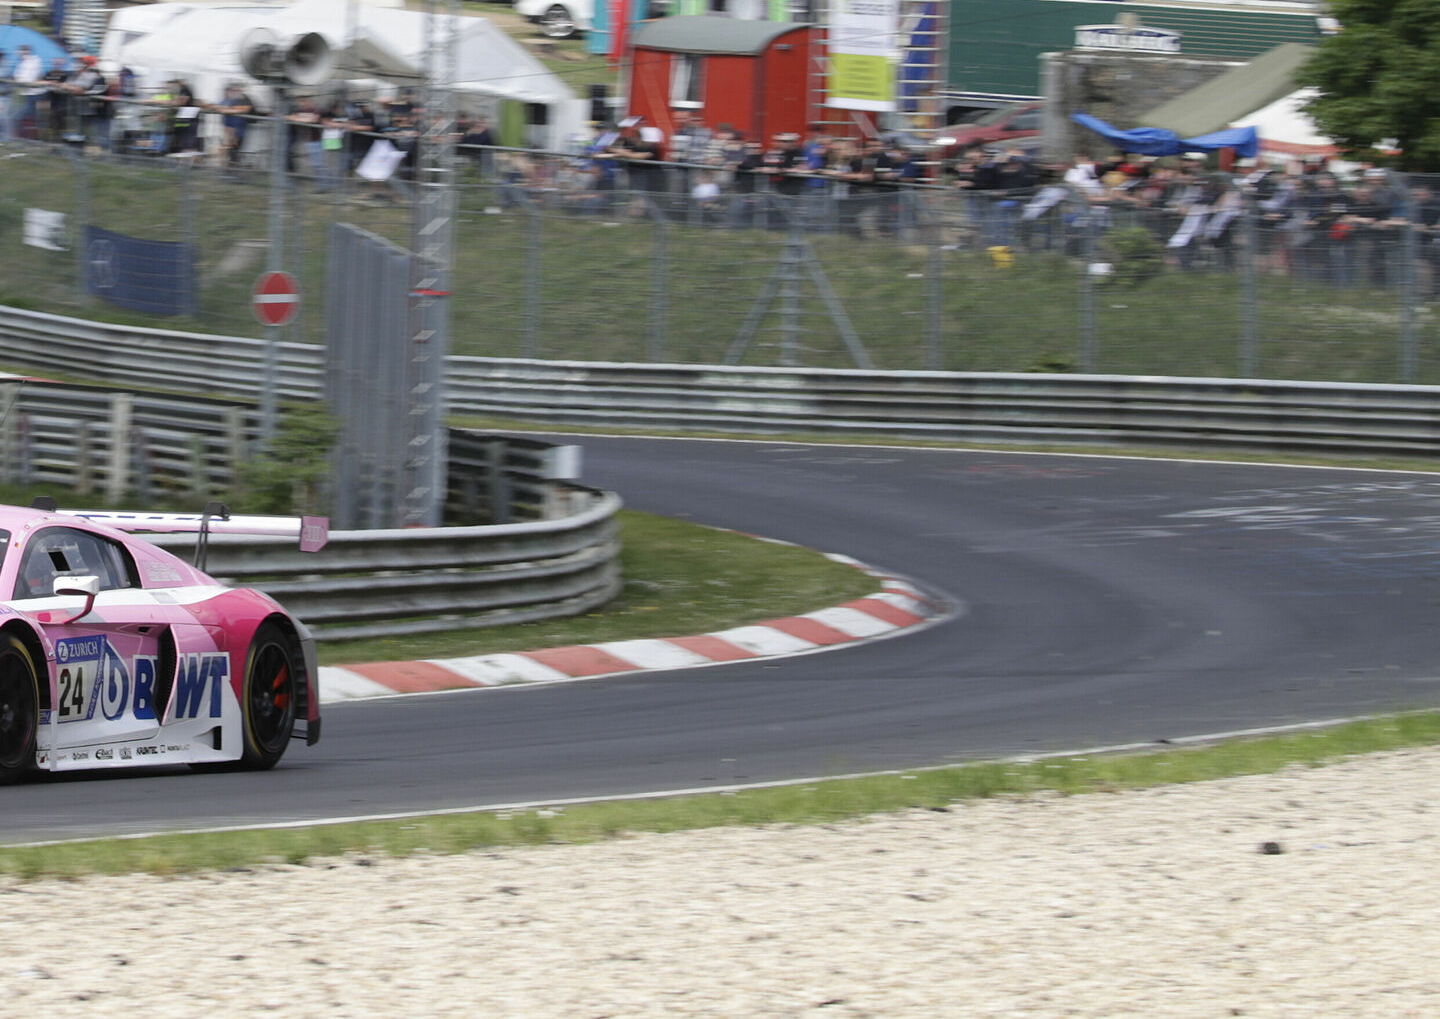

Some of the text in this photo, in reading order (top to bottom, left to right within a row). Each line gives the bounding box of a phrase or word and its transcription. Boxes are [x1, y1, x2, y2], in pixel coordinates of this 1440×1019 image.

[68, 641, 99, 658] ZURICH
[58, 667, 84, 717] 24
[132, 656, 228, 720] BWT
